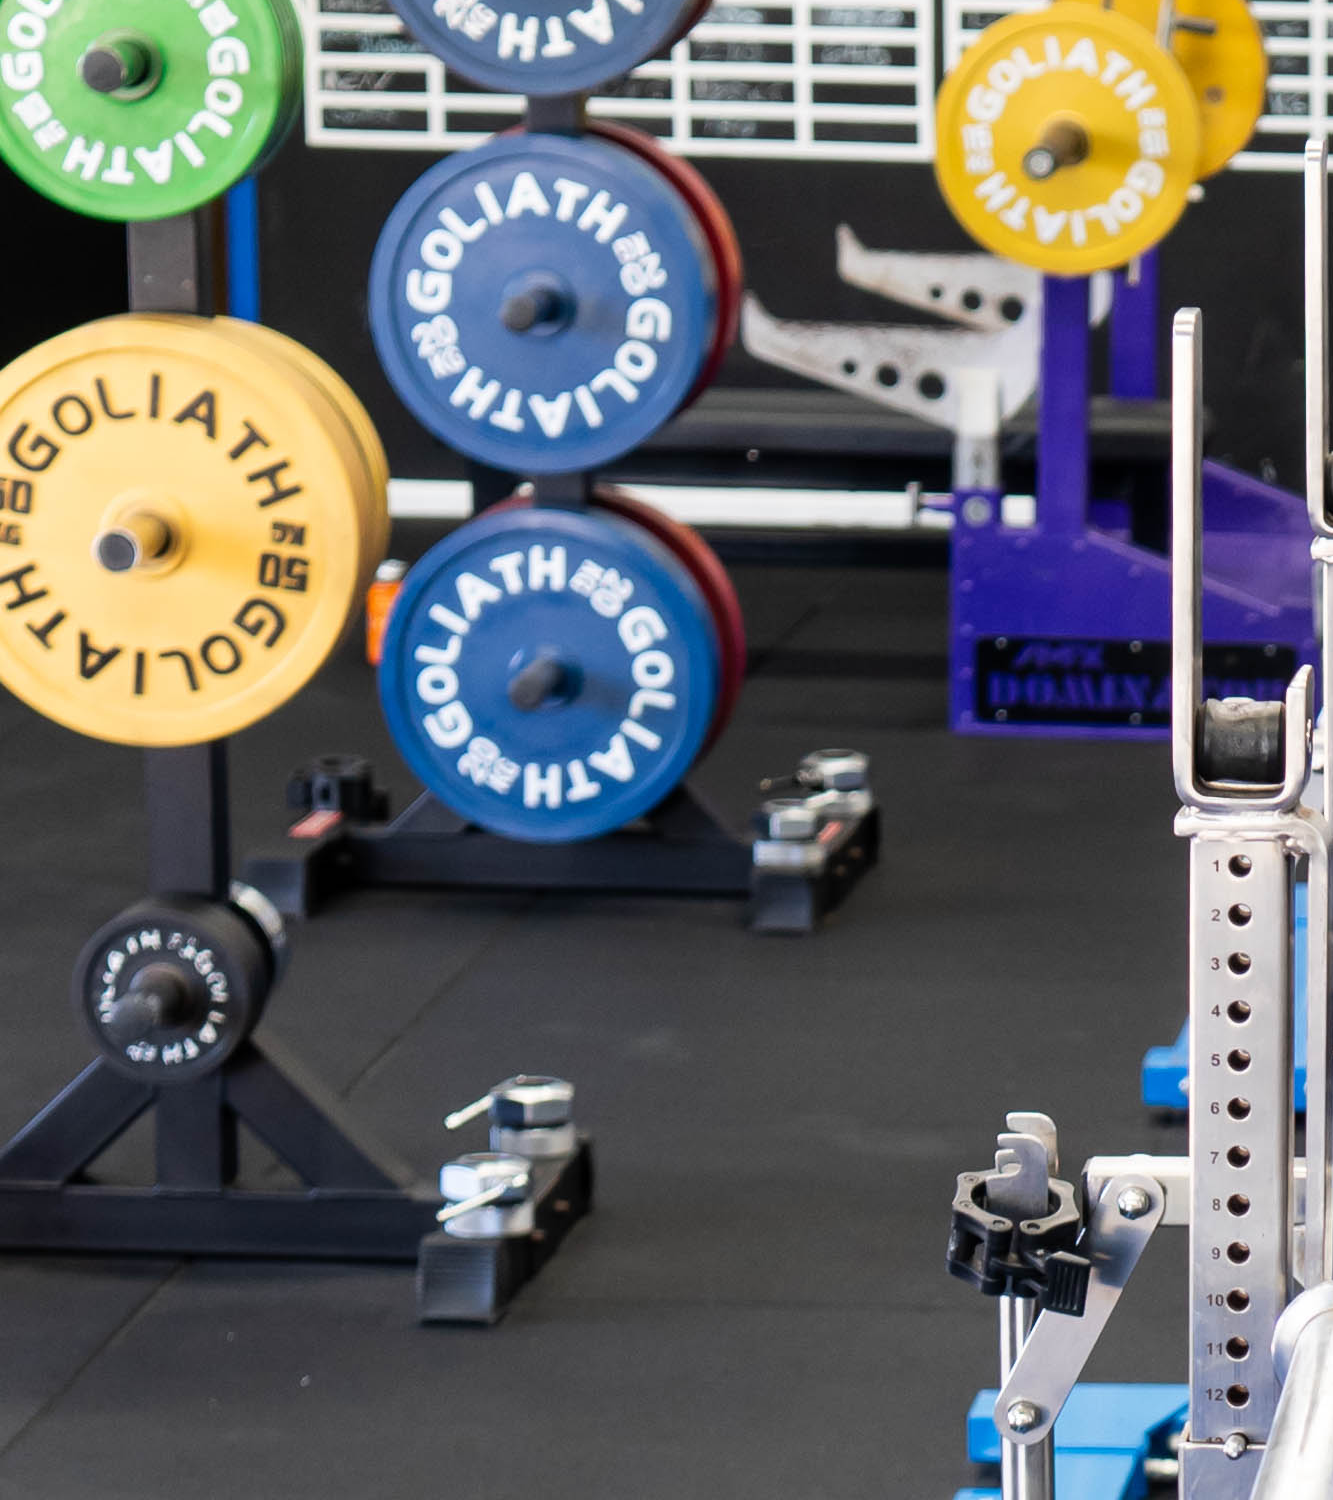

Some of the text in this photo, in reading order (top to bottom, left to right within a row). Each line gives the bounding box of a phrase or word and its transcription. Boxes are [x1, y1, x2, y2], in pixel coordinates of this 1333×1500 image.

[966, 35, 1158, 123] GOLIATH
[61, 36, 250, 186] GOLIATH
[973, 160, 1165, 247] GOLIATH
[406, 172, 629, 314] GOLIATH
[449, 297, 673, 439] GOLIATH
[8, 374, 303, 509] GOLIATH
[257, 552, 311, 593] 50
[0, 563, 288, 695] GOLIATH
[414, 544, 568, 750] GOLIATH
[522, 605, 677, 810] GOLIATH
[1213, 860, 1220, 872] 1
[1211, 909, 1220, 922] 2
[1211, 958, 1220, 970] 3
[1211, 1005, 1220, 1017] 4
[1211, 1054, 1220, 1067] 5
[1211, 1102, 1220, 1115] 6
[1210, 1151, 1219, 1164] 7
[1212, 1199, 1220, 1211] 8
[1211, 1247, 1220, 1260] 9
[1206, 1294, 1225, 1307] 10
[1206, 1343, 1223, 1355] 11
[1206, 1388, 1223, 1401] 12
